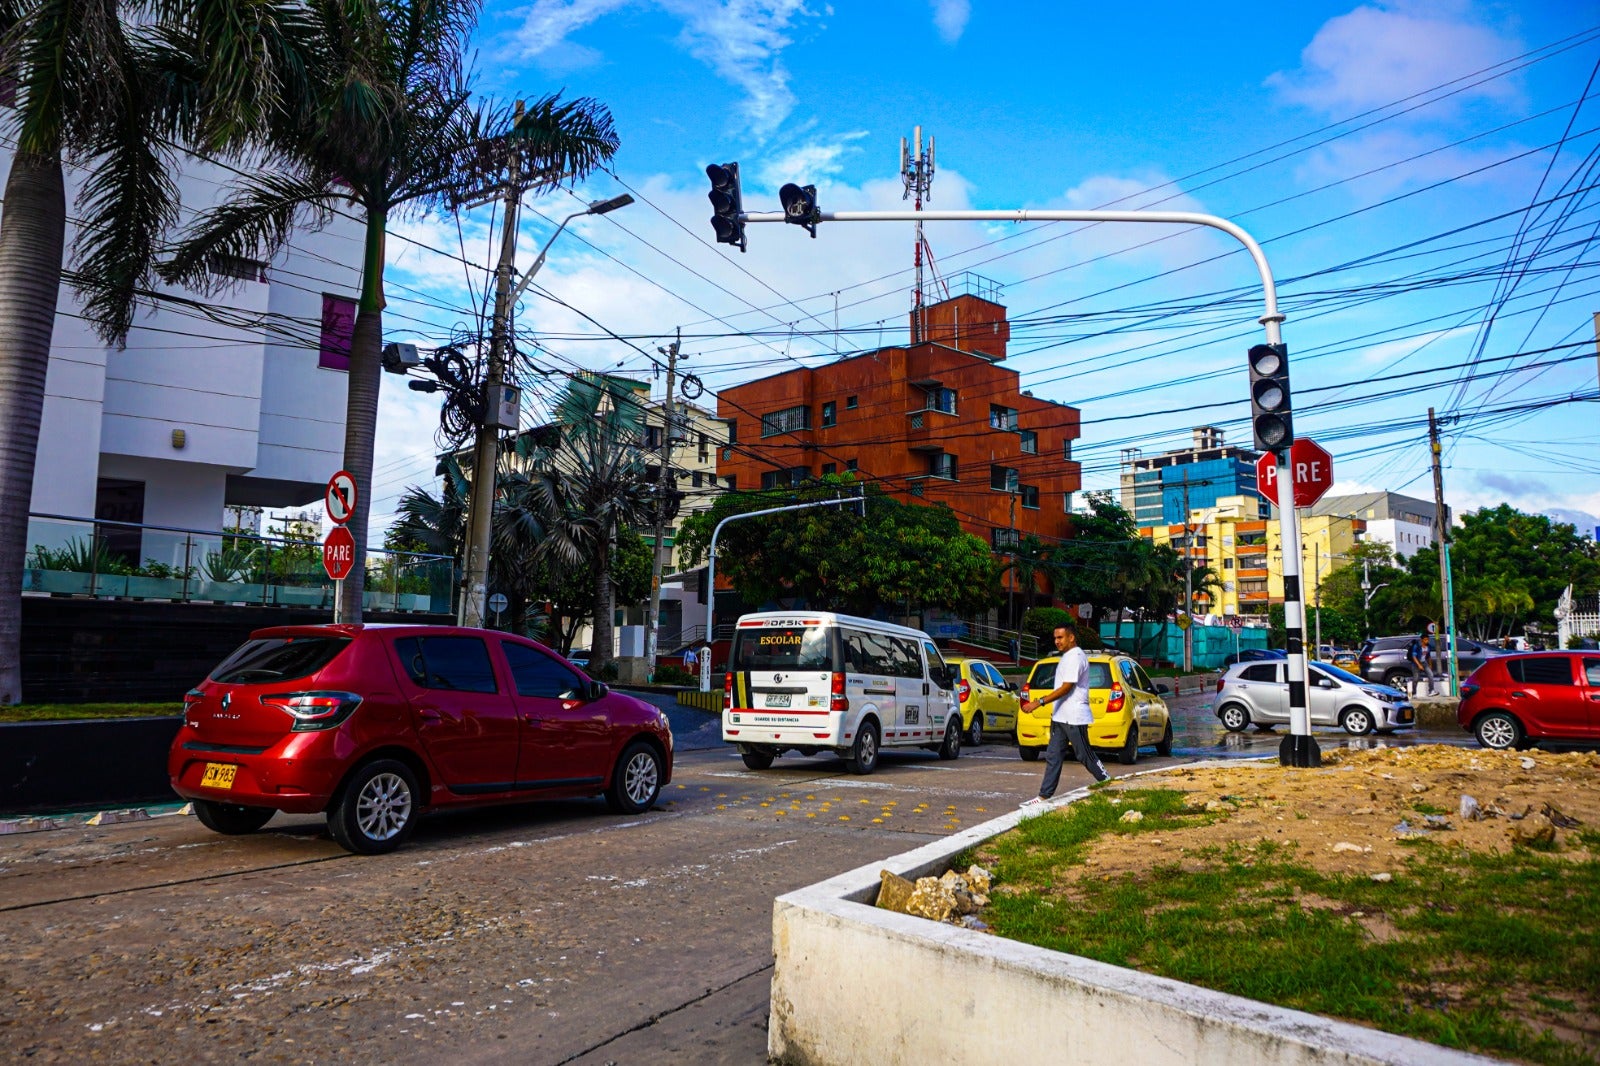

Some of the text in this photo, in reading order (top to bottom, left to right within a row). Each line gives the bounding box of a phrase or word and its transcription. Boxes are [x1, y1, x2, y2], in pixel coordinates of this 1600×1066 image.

[1266, 461, 1322, 486] PRE
[327, 545, 350, 561] PARE
[771, 619, 803, 627] DFSK
[760, 635, 802, 645] ESCOLAR
[219, 767, 235, 782] 983
